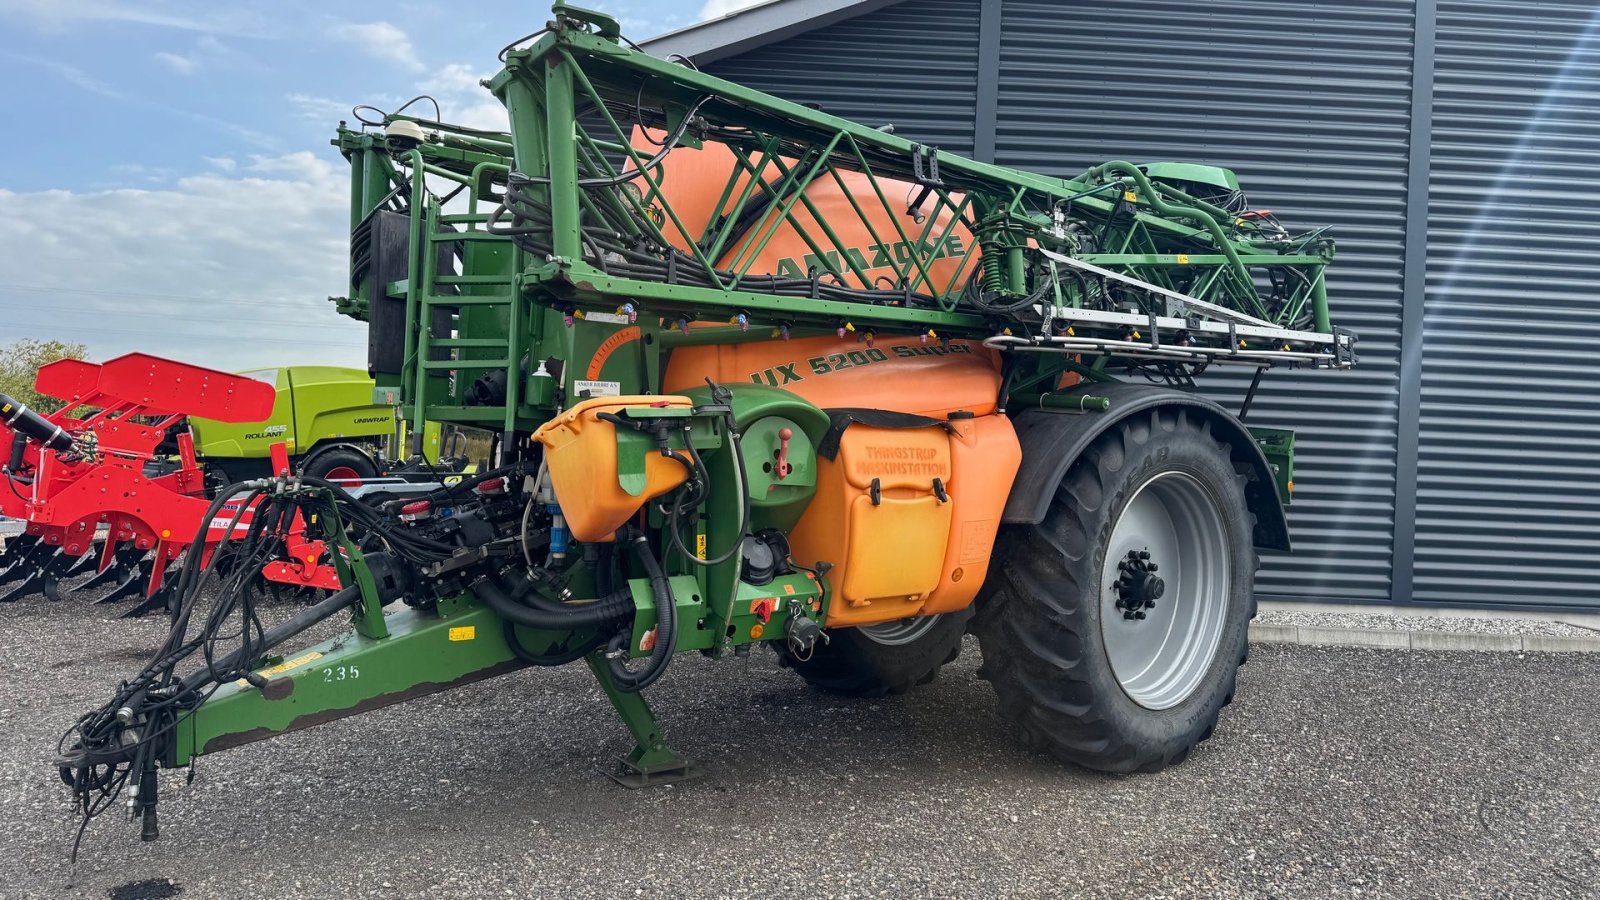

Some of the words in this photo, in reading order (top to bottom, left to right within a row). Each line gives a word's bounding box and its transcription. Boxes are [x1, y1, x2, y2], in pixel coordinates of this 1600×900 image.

[777, 234, 966, 280] AMAZONE
[750, 362, 803, 388] UX
[807, 347, 889, 375] 5200
[891, 344, 972, 358] Super
[353, 416, 390, 424] UNIWRAP
[264, 424, 288, 433] 455
[245, 432, 283, 440] ROLLANT
[865, 446, 937, 461] THINGSTRUP
[856, 462, 947, 475] MASKINSTATION
[322, 665, 360, 682] 235
